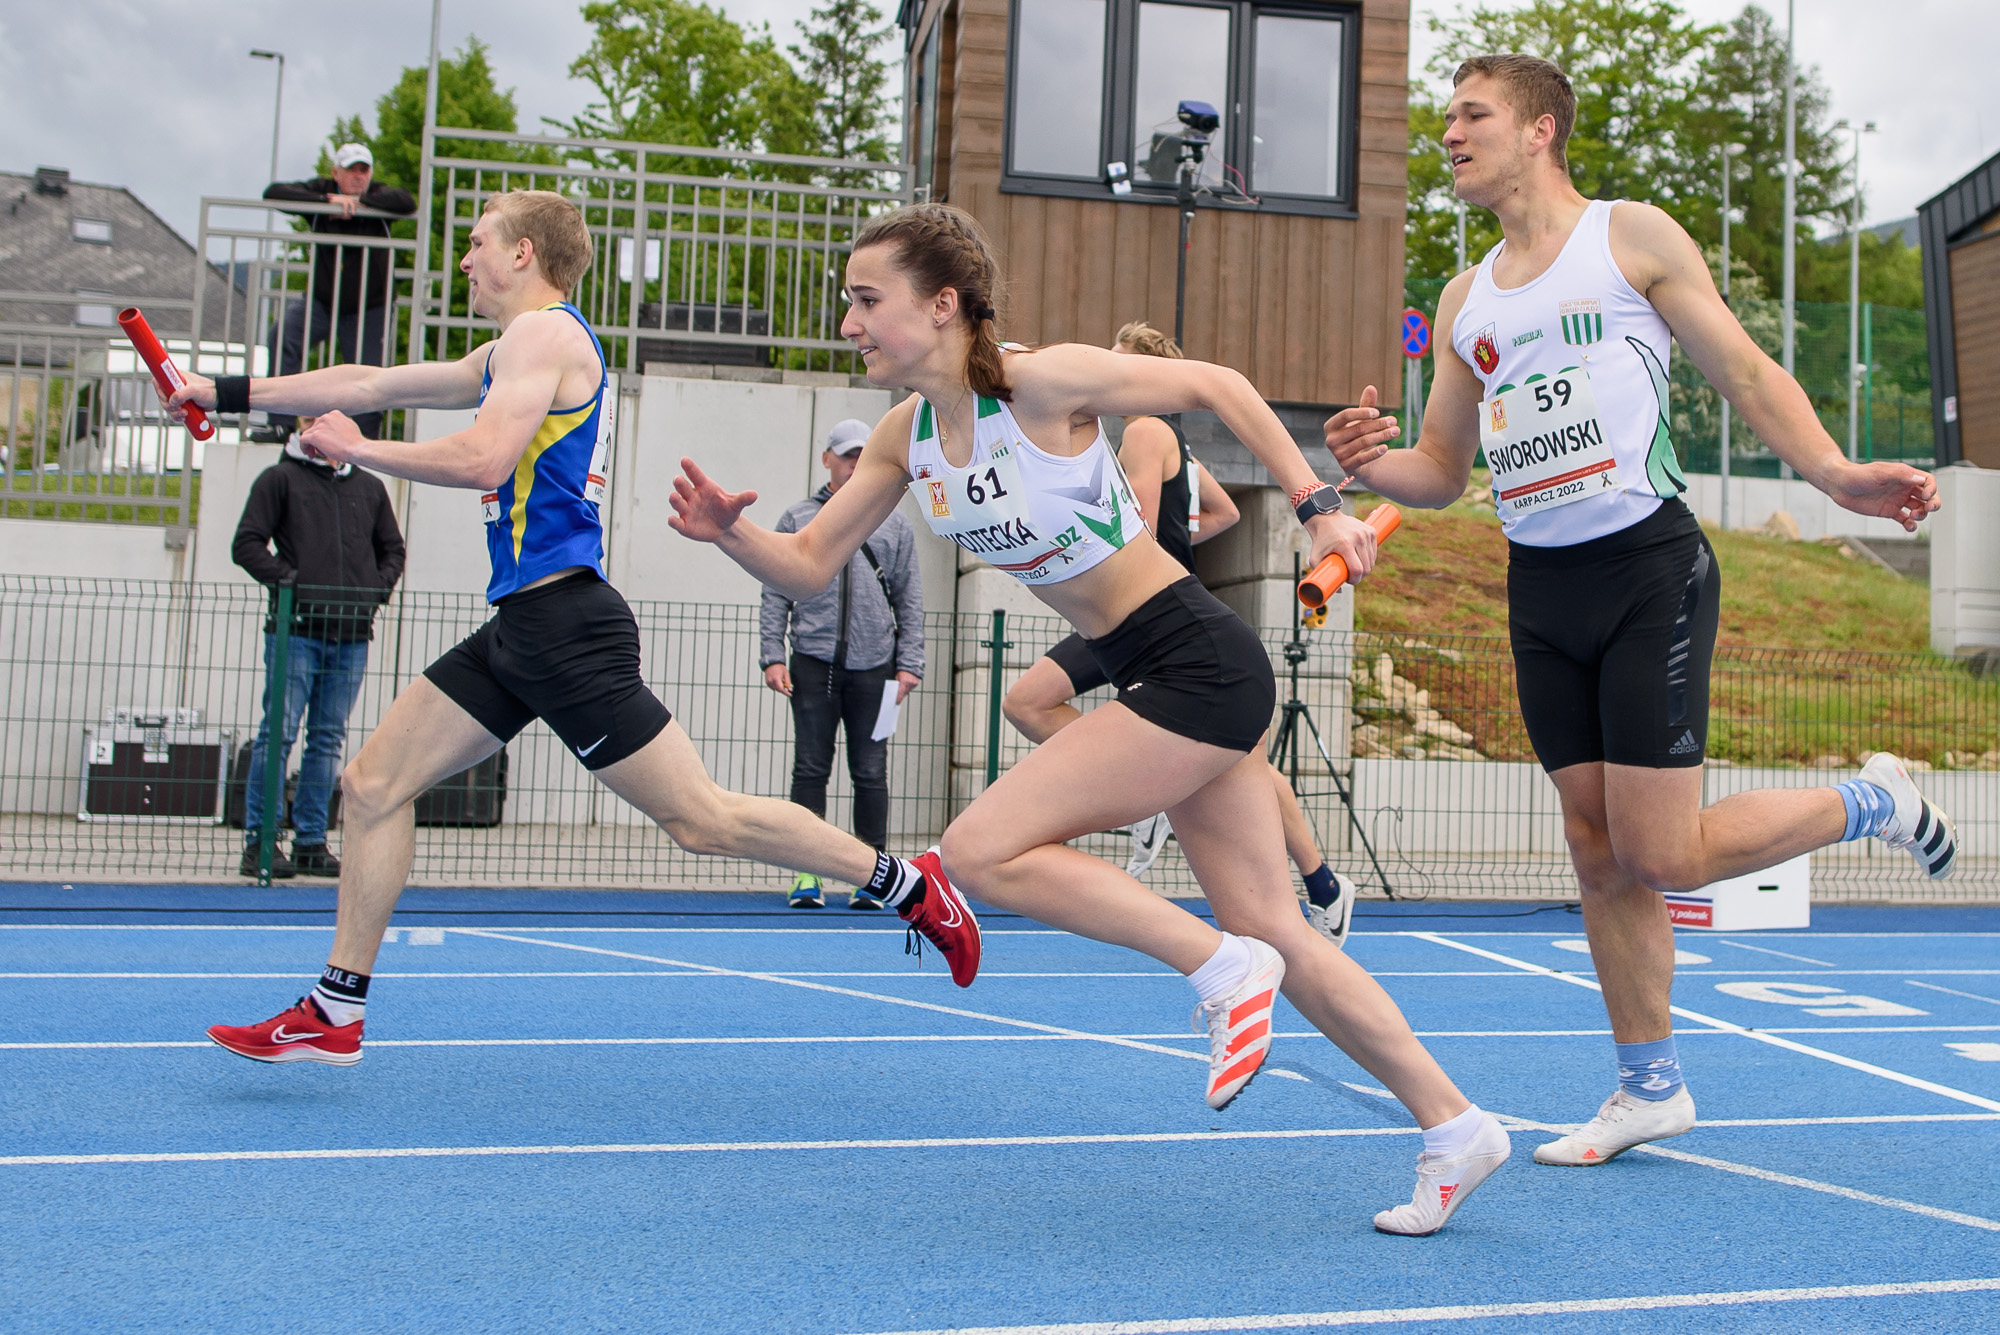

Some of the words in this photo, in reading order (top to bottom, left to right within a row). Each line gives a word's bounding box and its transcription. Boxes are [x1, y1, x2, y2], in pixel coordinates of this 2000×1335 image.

[1534, 379, 1572, 412] 59
[1489, 418, 1603, 476] SWOROWSKI
[966, 466, 1008, 505] 61
[1513, 490, 1555, 510] KARPACZ
[1557, 481, 1585, 498] 2022
[940, 517, 1039, 553] OJTECKA
[1049, 525, 1083, 548] DZ
